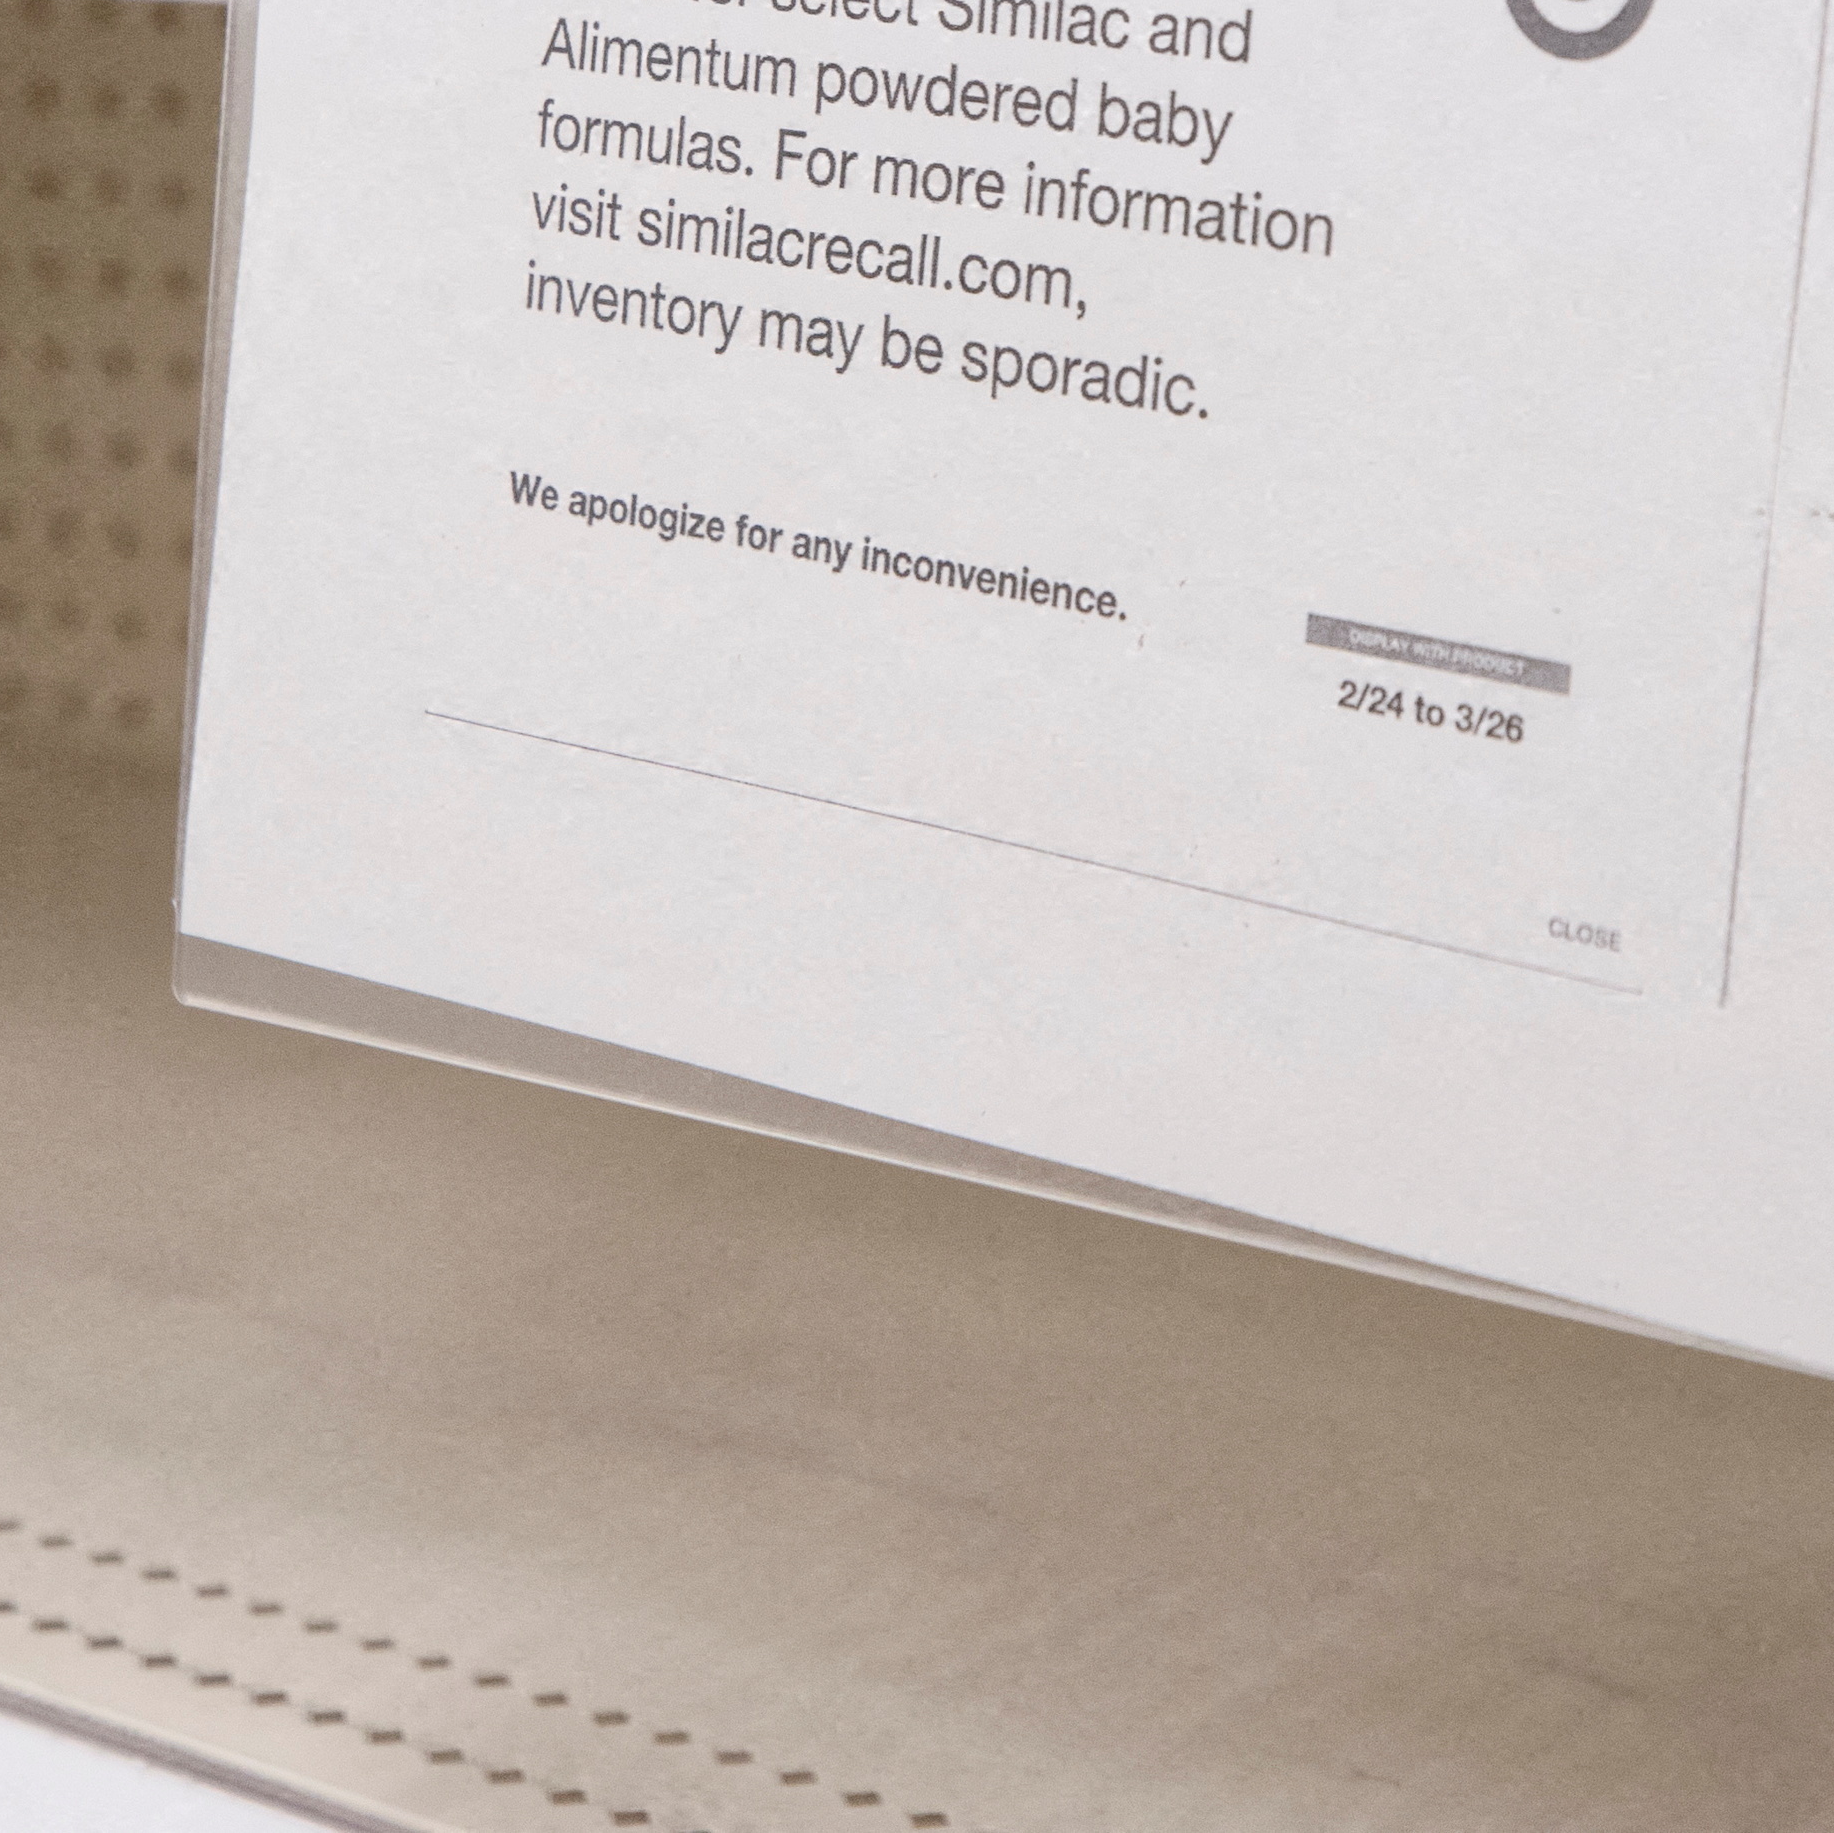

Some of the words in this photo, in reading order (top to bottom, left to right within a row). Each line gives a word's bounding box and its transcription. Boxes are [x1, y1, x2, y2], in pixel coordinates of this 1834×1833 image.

[540, 17, 797, 98] Alimentum
[814, 61, 1079, 133] powdered
[1097, 81, 1234, 166] baby
[1148, 8, 1254, 64] and
[537, 97, 754, 177] formulas.
[774, 127, 859, 190] For
[872, 154, 1006, 211] more
[1024, 160, 1334, 257] information
[532, 182, 623, 242] visit
[636, 197, 1087, 321] similacrecall.com,
[525, 258, 744, 356] inventory
[758, 308, 865, 375] may
[880, 313, 944, 375] be
[960, 340, 1209, 420] sporadic.
[509, 470, 559, 512] We
[567, 490, 726, 543] apologize
[734, 513, 785, 554] for
[791, 532, 854, 574] any
[861, 535, 1127, 622] inconvenience.
[1337, 679, 1405, 719] 2/24
[1414, 695, 1446, 728] to
[1454, 703, 1524, 744] 3/26
[1349, 628, 1409, 655] DISPLAY
[1414, 643, 1449, 660] WITH
[1450, 649, 1525, 677] PRODUCT
[1547, 916, 1622, 953] CLOSE
